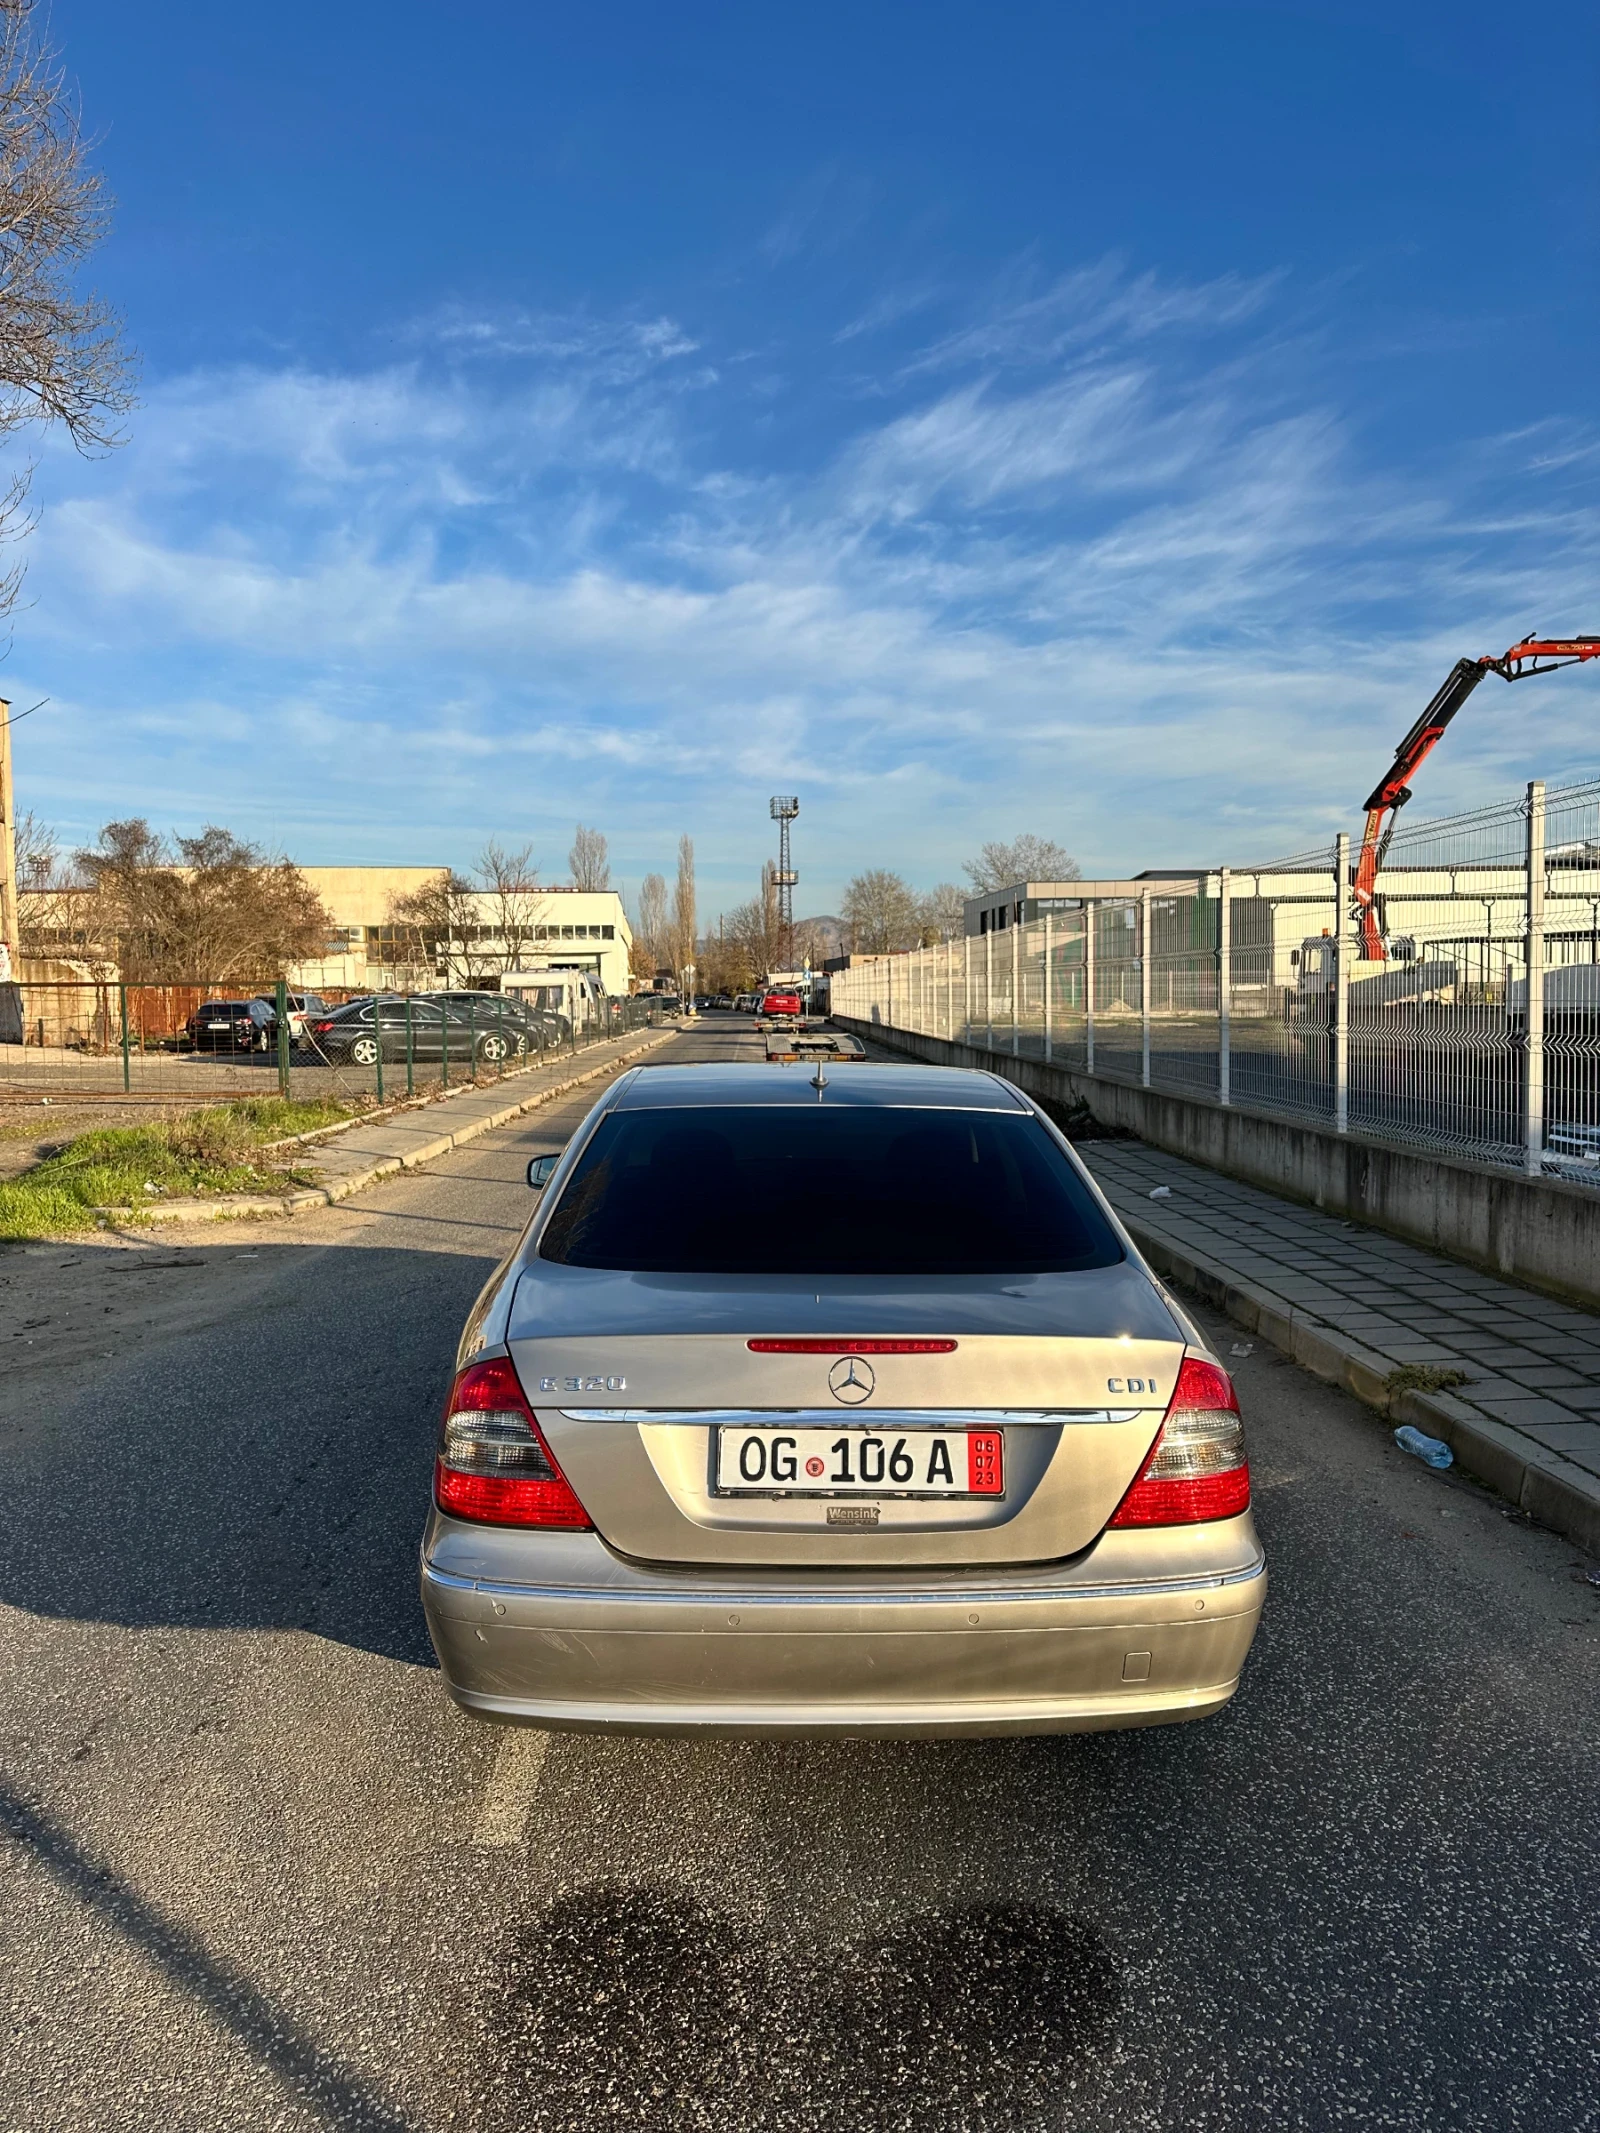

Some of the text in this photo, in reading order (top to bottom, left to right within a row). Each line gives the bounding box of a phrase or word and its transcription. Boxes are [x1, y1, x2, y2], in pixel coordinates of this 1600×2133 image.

[540, 1375, 627, 1392] E 320
[1107, 1377, 1157, 1394] CDI
[975, 1439, 995, 1453] 06
[739, 1435, 954, 1484] OG 106 A
[975, 1455, 995, 1470] 07
[975, 1471, 995, 1486] 23
[828, 1507, 878, 1519] Wensink
